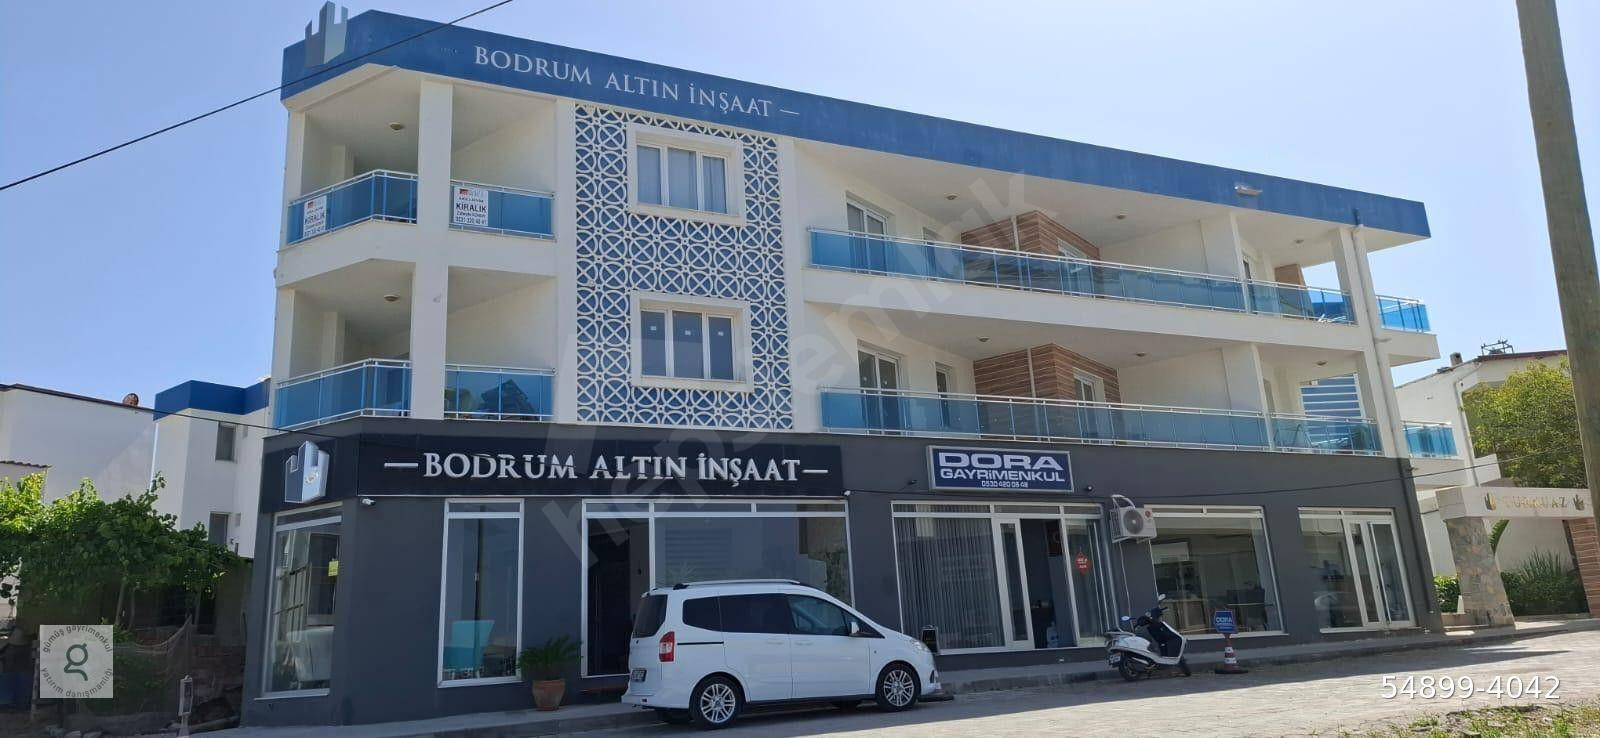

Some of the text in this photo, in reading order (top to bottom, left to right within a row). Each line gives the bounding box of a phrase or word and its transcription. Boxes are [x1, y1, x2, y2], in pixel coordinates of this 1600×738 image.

[474, 46, 773, 117] BODRUM ALTIN İNŞAAT
[424, 453, 801, 487] BODRUM ALTIN İNŞAAT
[938, 452, 1064, 471] DORA
